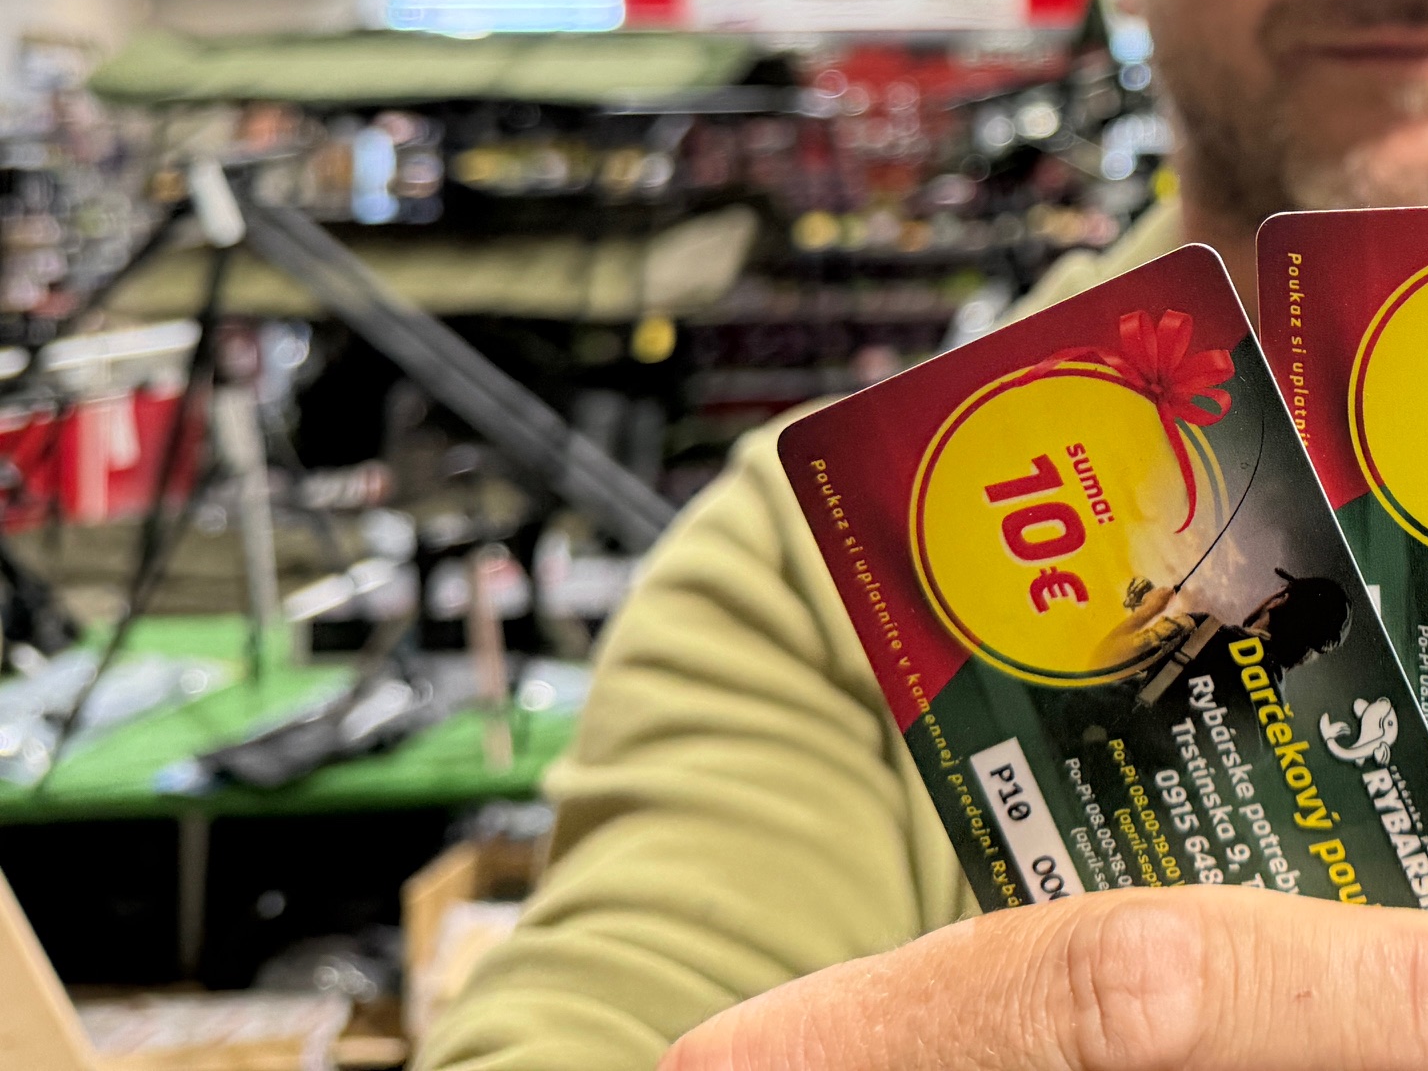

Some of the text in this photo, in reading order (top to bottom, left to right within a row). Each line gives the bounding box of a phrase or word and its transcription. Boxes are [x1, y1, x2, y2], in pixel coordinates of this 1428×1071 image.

[1288, 253, 1304, 327] Poukaz
[1292, 336, 1306, 353] si
[985, 454, 1089, 613] 10€
[1066, 443, 1114, 524] suma:
[811, 459, 849, 529] Poukaz
[845, 537, 863, 553] si
[855, 560, 902, 650] uplatnite
[899, 657, 910, 666] v
[908, 674, 959, 768] kamennej
[948, 774, 997, 854] predajni
[990, 764, 1031, 821] P10
[1173, 718, 1235, 842] Trstínska
[1226, 844, 1250, 871] 9,
[1189, 675, 1255, 800] Rybárske
[1229, 630, 1372, 905] Darčekový pou
[1066, 758, 1135, 893] Po-Pi 08.00-18.0
[1109, 739, 1138, 784] Po-Pi
[1130, 786, 1181, 880] 08.00-19.00
[1156, 770, 1224, 884] 0915 648
